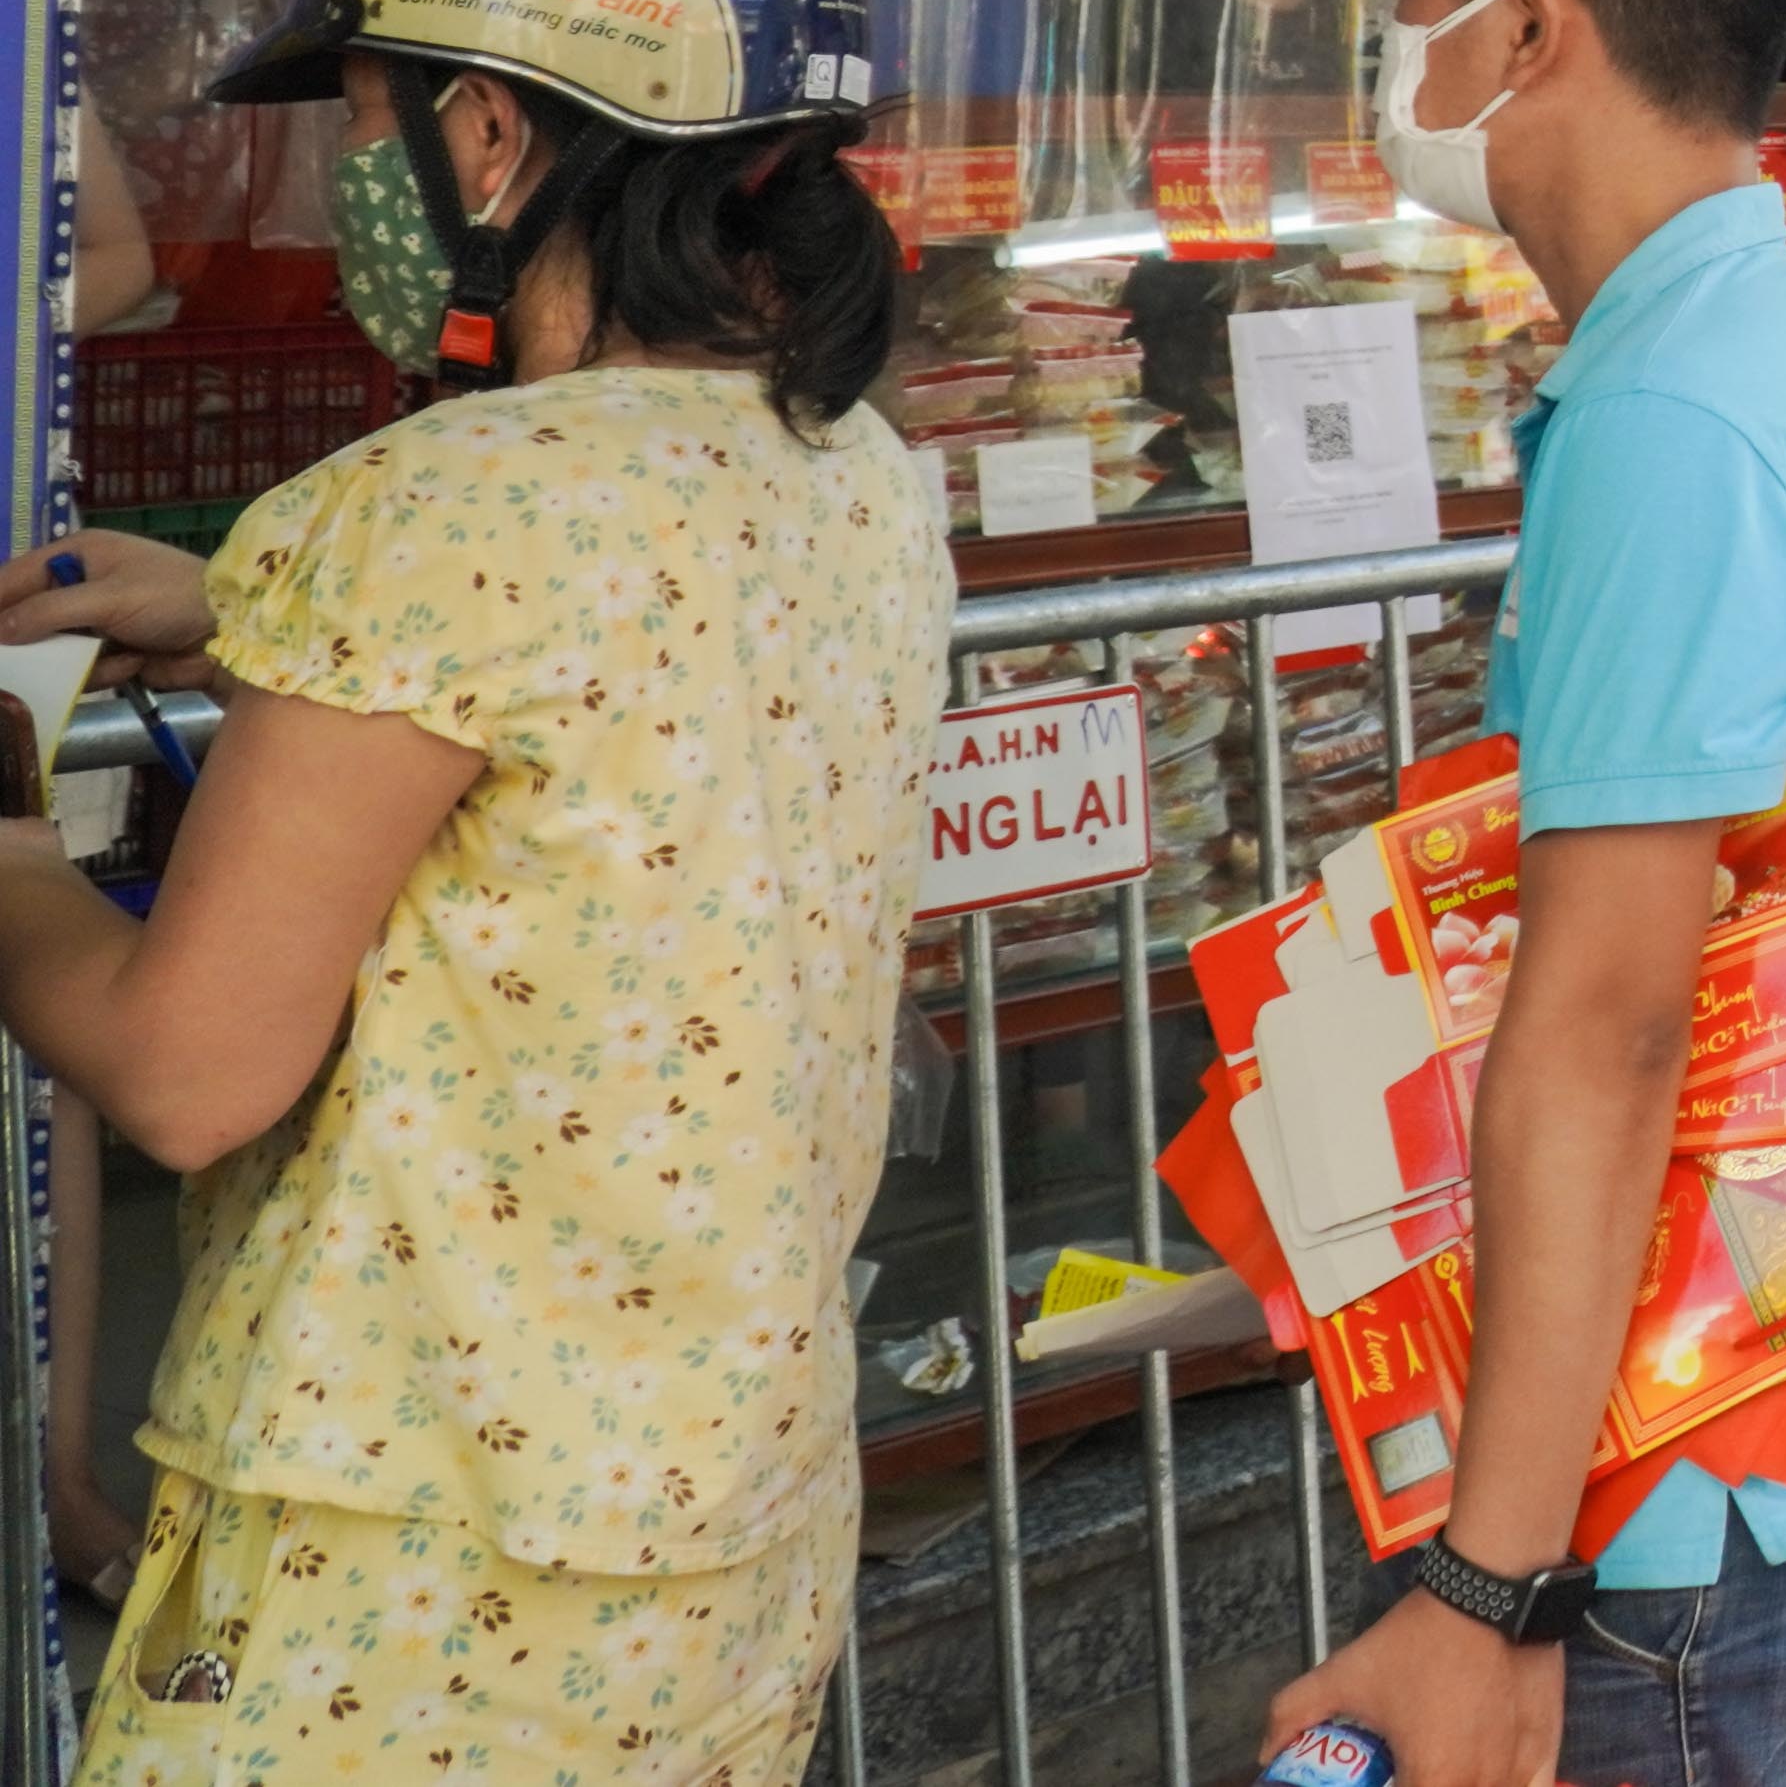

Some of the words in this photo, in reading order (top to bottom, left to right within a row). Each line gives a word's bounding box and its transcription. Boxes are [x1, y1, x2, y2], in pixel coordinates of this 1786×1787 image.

[487, 0, 564, 31] những
[624, 31, 670, 54] mơ
[927, 723, 1059, 774] .A.H.N
[1033, 774, 1127, 846] LẠI
[1429, 891, 1466, 915] Bình
[1468, 874, 1518, 900] Chung
